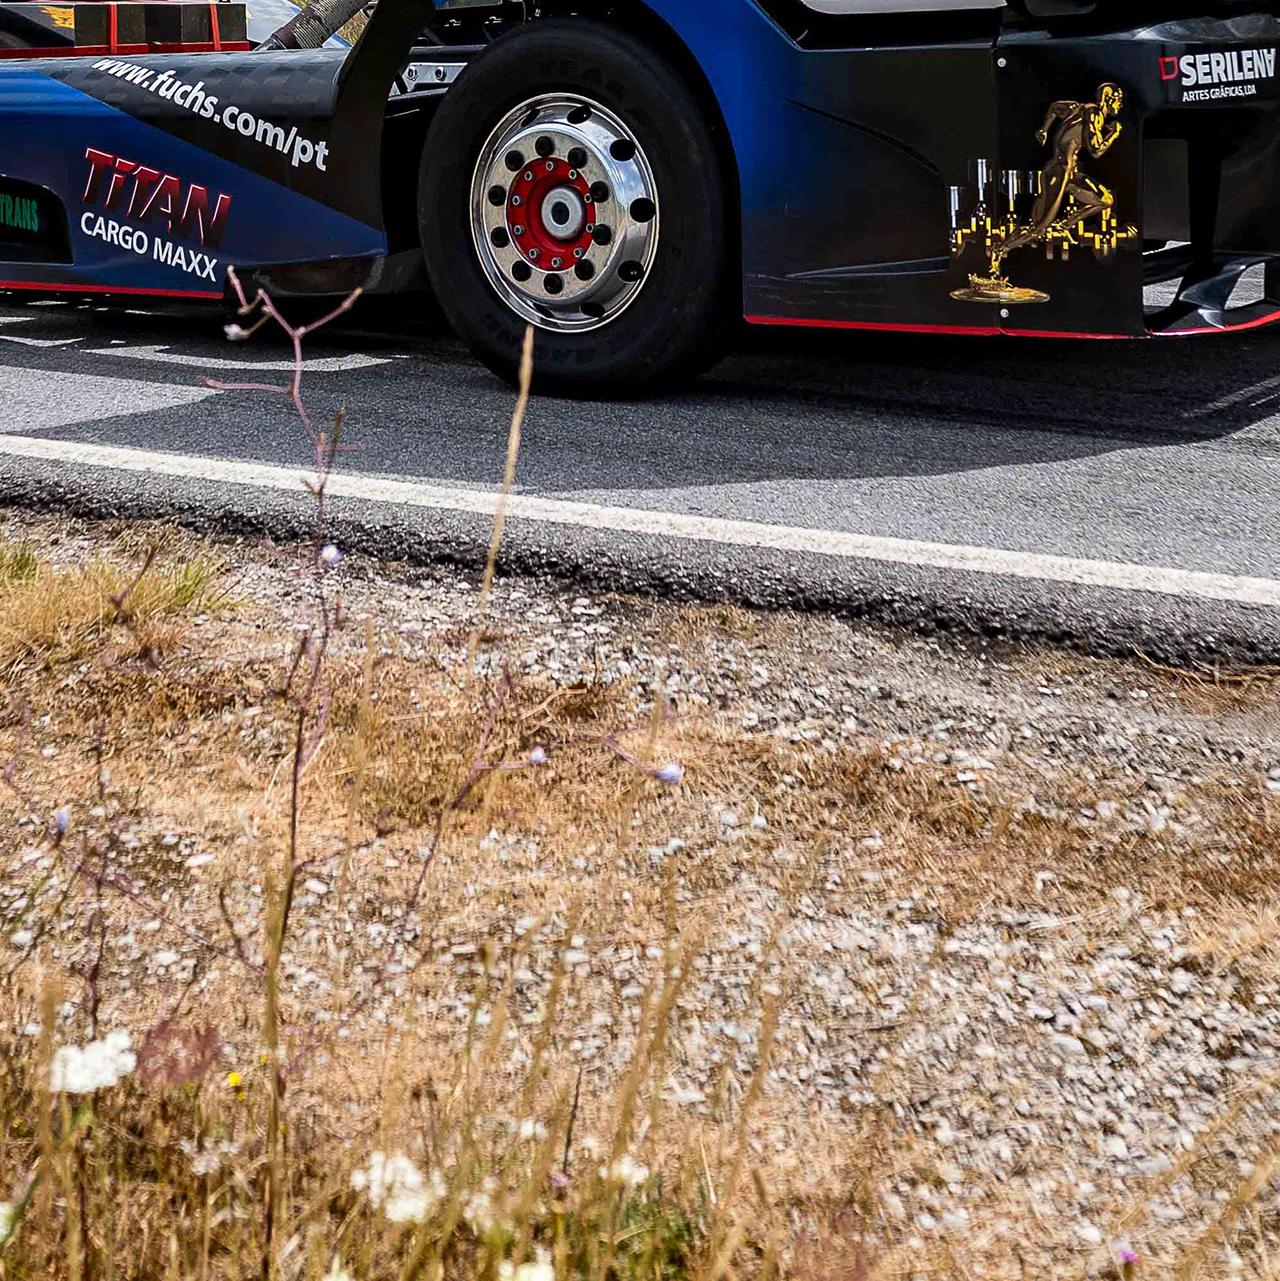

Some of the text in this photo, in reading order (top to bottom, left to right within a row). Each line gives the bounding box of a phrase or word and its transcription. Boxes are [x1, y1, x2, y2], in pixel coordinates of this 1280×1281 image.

[91, 58, 330, 171] www.fuchs.com/pt
[1182, 88, 1210, 102] ARTES
[80, 212, 217, 283] CARGO MAXX
